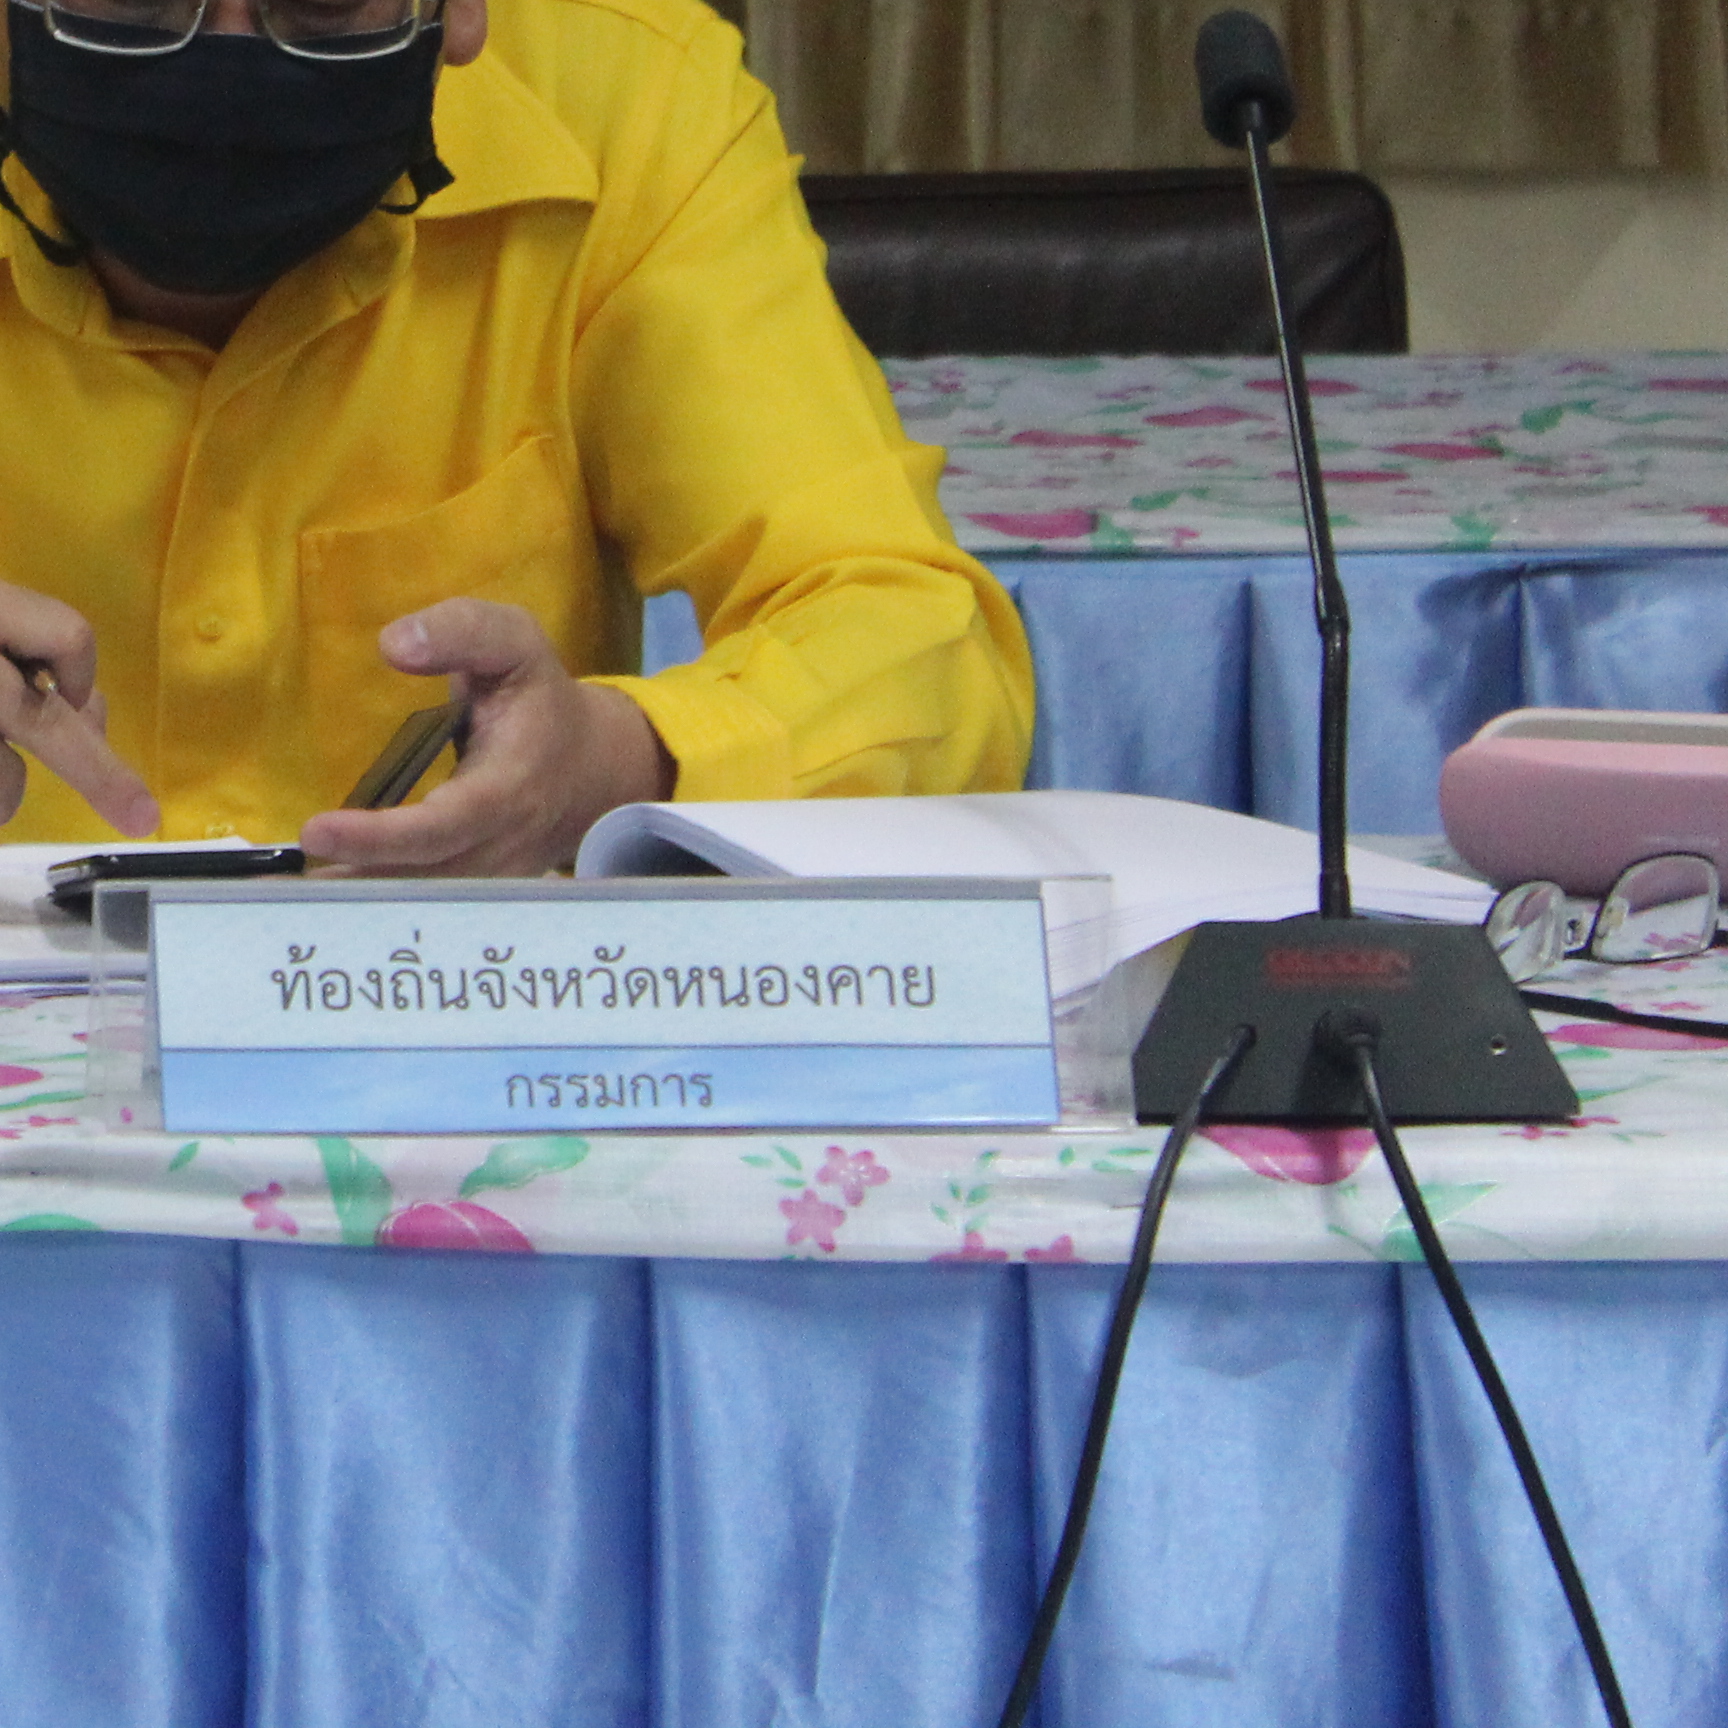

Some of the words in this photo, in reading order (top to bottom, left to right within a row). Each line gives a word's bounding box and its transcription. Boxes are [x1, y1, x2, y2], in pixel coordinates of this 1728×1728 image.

[270, 930, 936, 1011] ท้องถิ่นจังหวัดหนองคาย
[504, 1070, 714, 1109] กรรมการ
